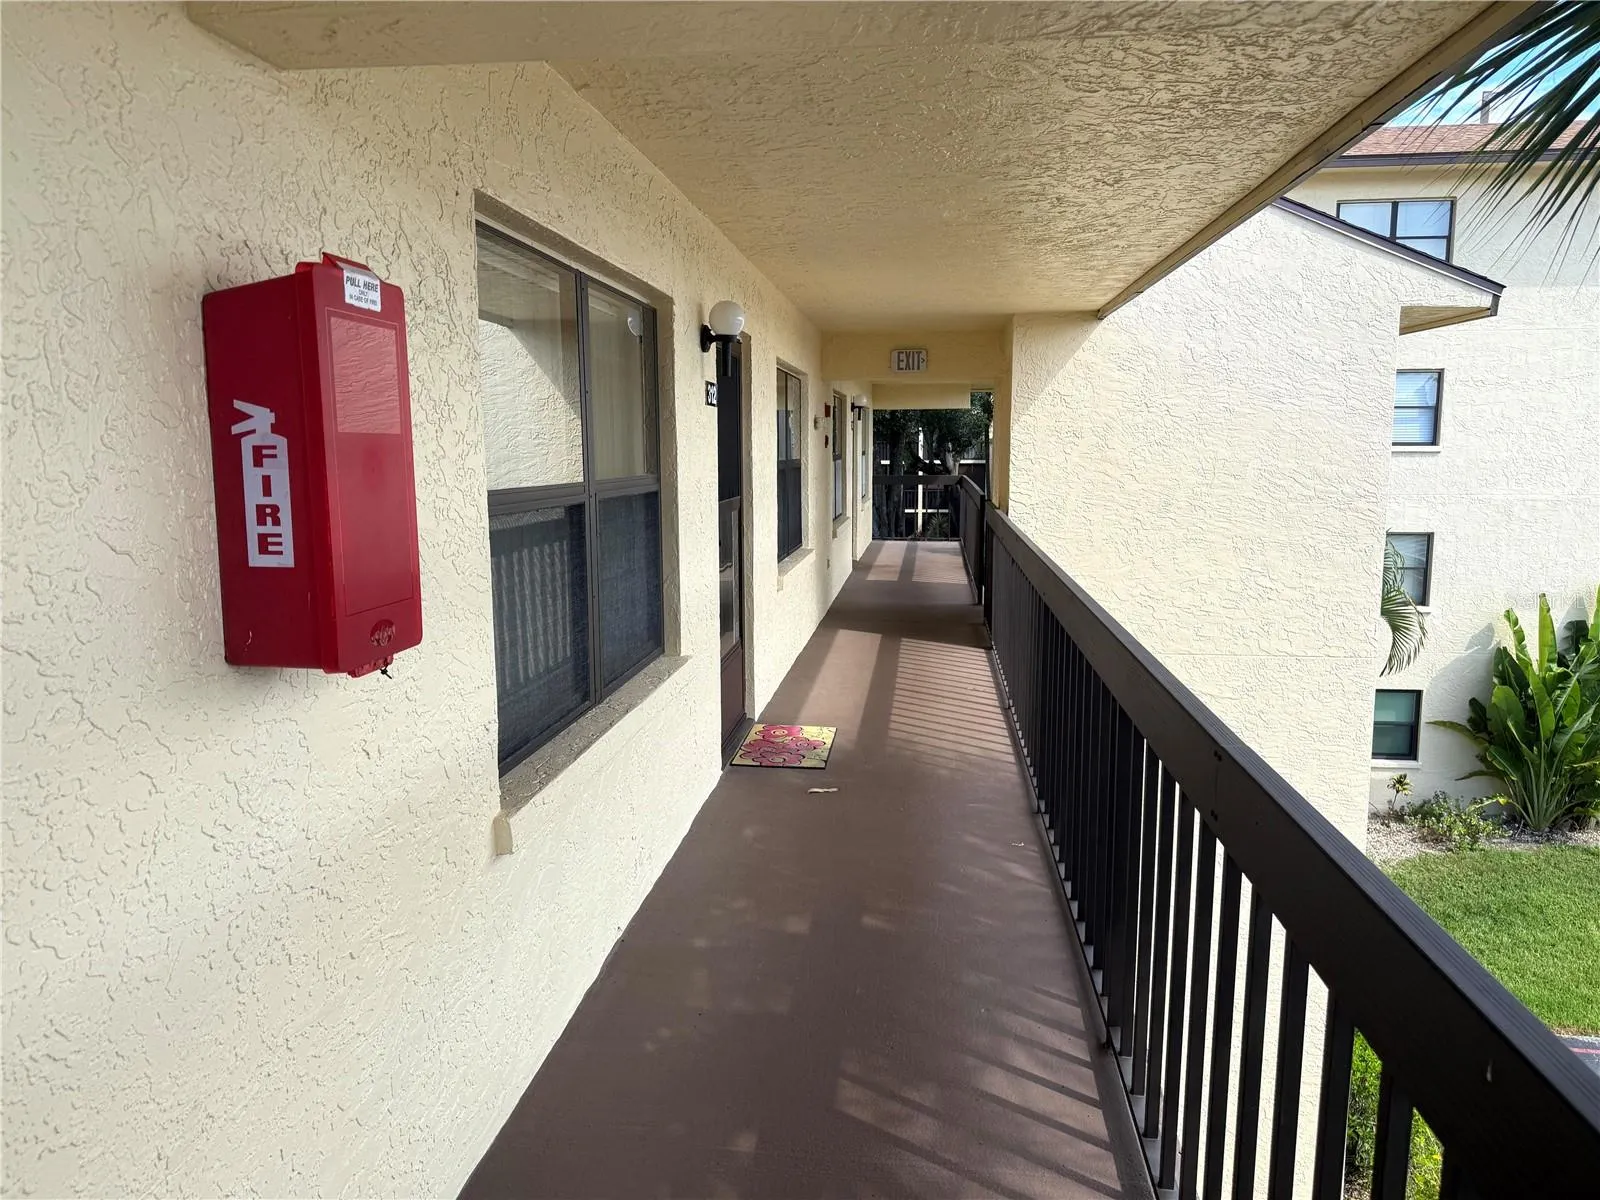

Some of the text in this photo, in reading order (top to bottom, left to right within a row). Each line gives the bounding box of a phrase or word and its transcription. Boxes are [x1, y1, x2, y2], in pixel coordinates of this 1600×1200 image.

[346, 276, 378, 292] PULL HERE
[897, 350, 922, 371] EXIT
[252, 445, 284, 556] FIRE
